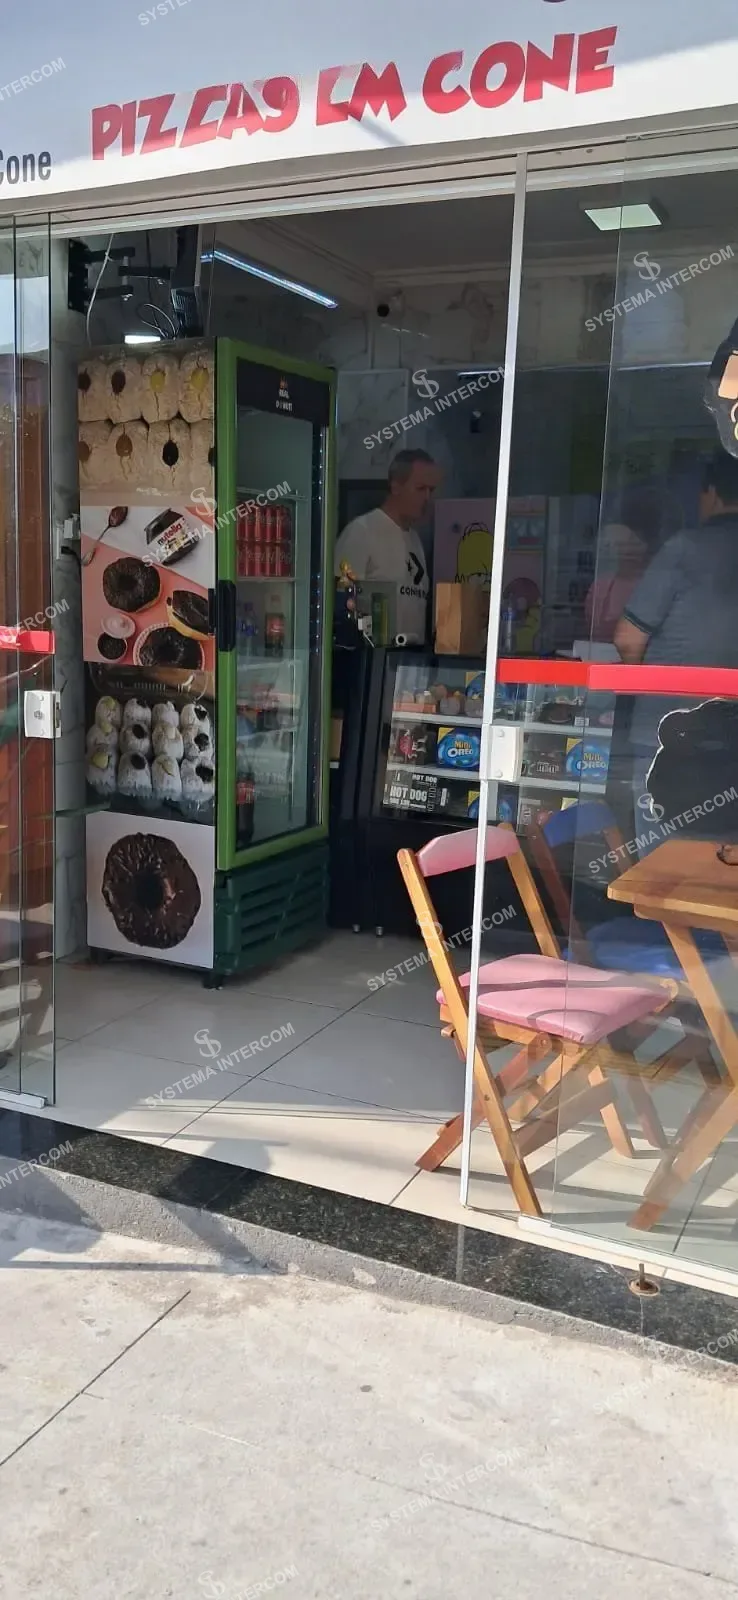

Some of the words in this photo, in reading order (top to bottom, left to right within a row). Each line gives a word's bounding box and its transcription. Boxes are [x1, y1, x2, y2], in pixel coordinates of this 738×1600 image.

[422, 25, 618, 114] CONE
[448, 748, 474, 757] OREO
[576, 760, 607, 770] OREO
[390, 785, 409, 799] HOT
[409, 788, 428, 802] DOG
